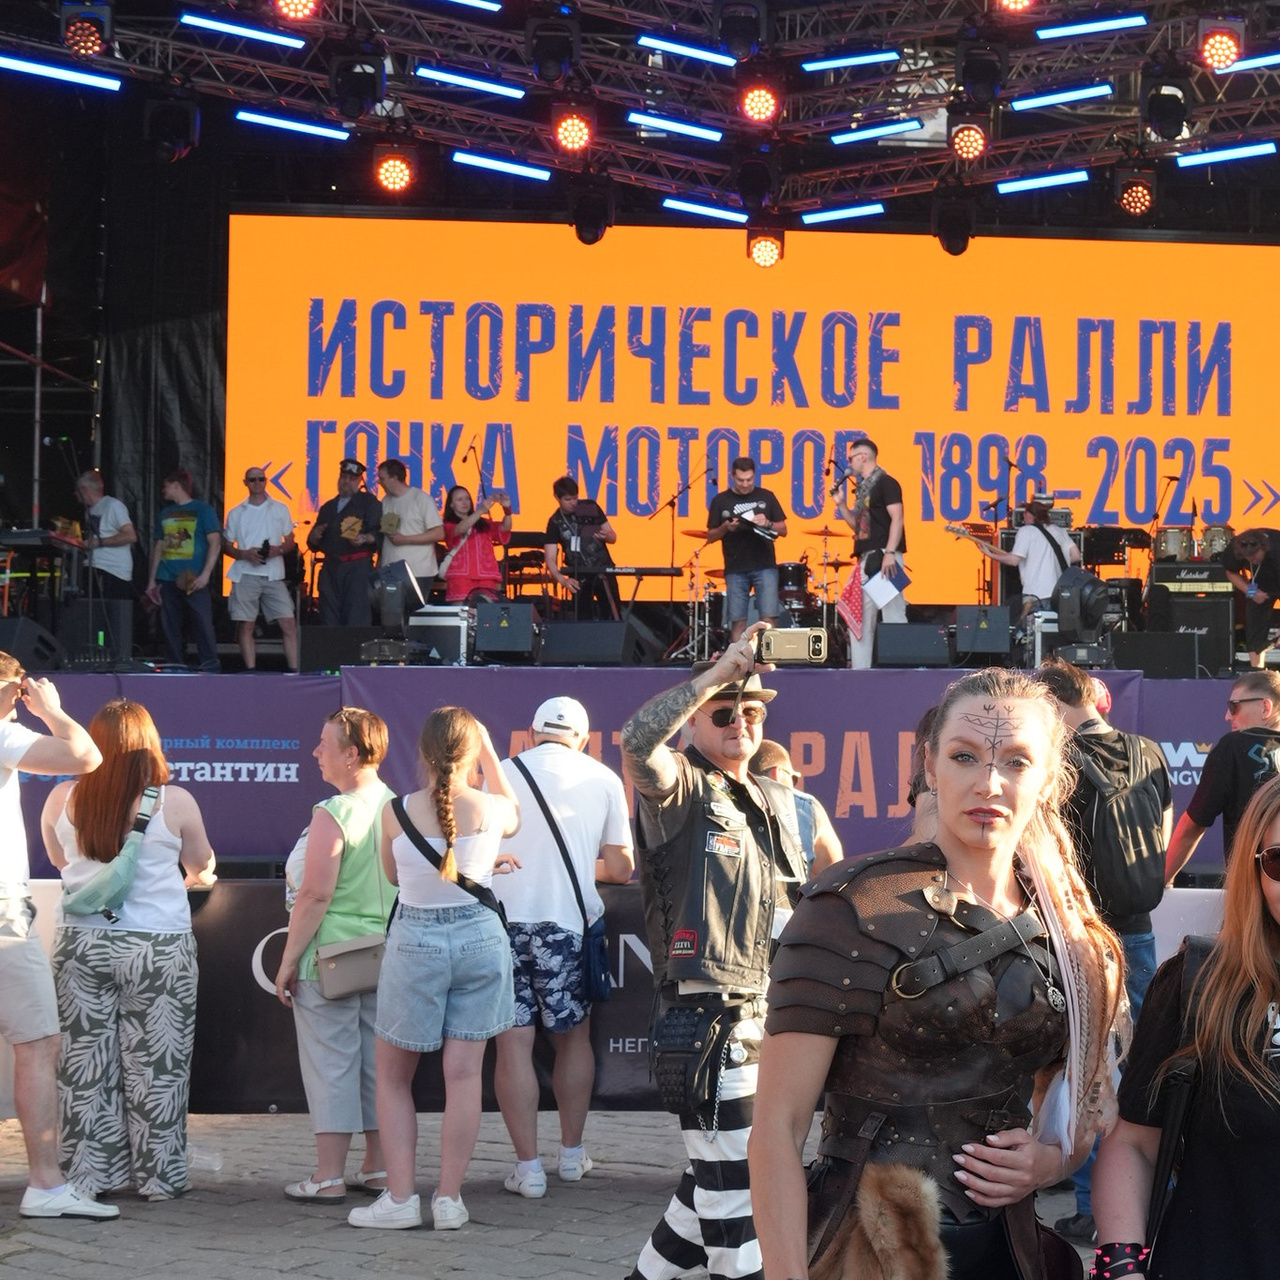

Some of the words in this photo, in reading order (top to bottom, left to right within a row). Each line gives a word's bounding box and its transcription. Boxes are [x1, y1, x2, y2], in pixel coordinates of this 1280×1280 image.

[307, 297, 901, 411] ИСТОРИЧЕСКОЕ
[953, 313, 1232, 417] РАЛЛИ
[1176, 569, 1210, 579] Marshall
[215, 738, 300, 750] комплекс
